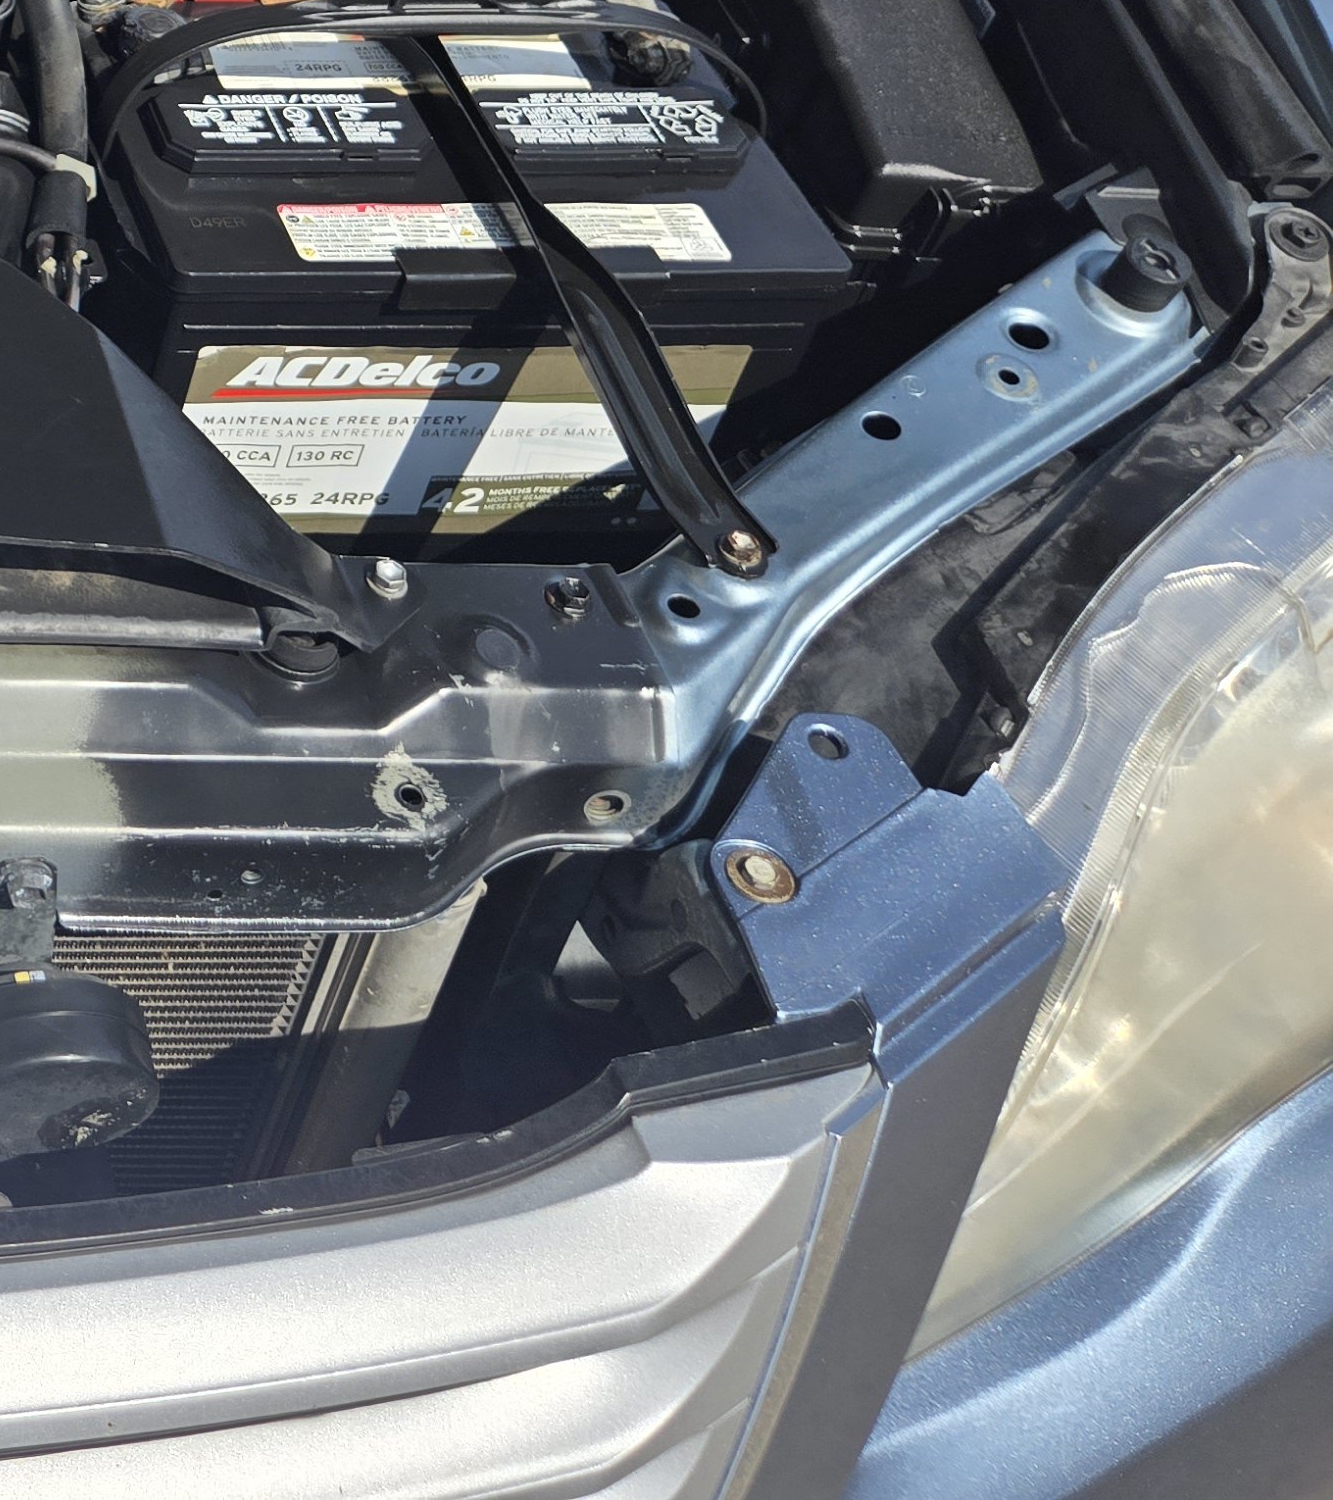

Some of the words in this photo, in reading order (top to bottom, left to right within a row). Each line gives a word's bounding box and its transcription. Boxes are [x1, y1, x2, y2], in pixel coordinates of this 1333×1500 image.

[294, 62, 343, 72] 24RPG
[217, 94, 287, 105] DANGER
[300, 94, 363, 105] POISON
[226, 354, 501, 389] ACDelco
[202, 415, 330, 426] MAINTENANCE
[336, 415, 381, 425] FREE
[387, 415, 467, 425] BATTERY
[276, 428, 315, 438] SANS
[321, 428, 406, 438] ENTRETIEN
[421, 425, 485, 438] BATERÍA
[490, 427, 534, 438] LIBRE
[539, 427, 557, 437] DE
[236, 450, 272, 461] CCA
[295, 450, 325, 462] 130
[330, 450, 355, 461] RC
[489, 487, 532, 497] MONTHS
[533, 486, 562, 495] FREE
[309, 491, 391, 506] 24RPG
[420, 486, 486, 514] 42
